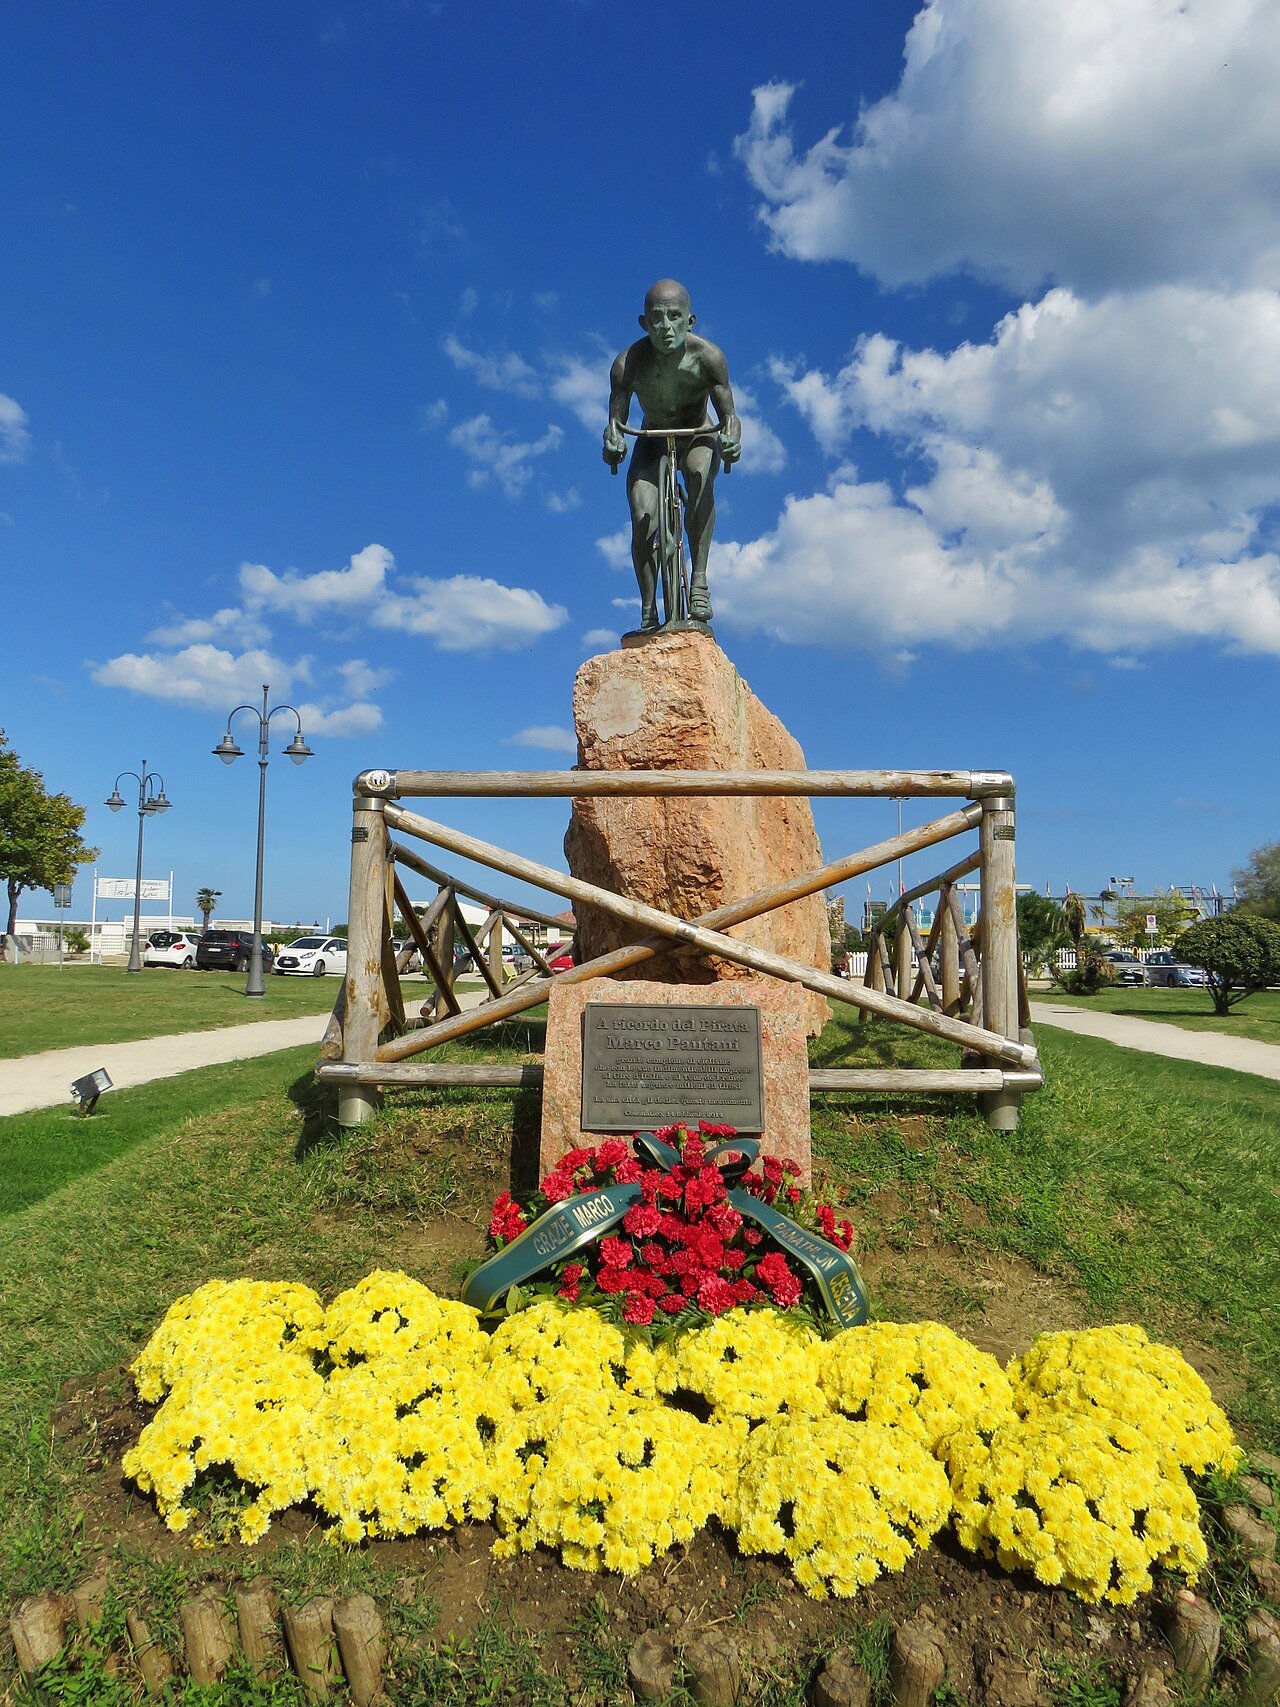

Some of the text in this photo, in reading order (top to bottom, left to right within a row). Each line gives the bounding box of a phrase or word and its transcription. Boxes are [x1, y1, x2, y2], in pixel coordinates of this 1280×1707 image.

[596, 1018, 749, 1032] A ricordo del Pirata
[606, 1035, 741, 1052] Marco Pantani
[647, 1057, 685, 1066] campione
[697, 1058, 731, 1066] ciclismo
[683, 1074, 702, 1082] Tour
[716, 1075, 744, 1083] France
[708, 1082, 717, 1090] di
[533, 1194, 615, 1256] GRAZIE MARCO
[773, 1222, 862, 1322] PANATHLON CESENA
